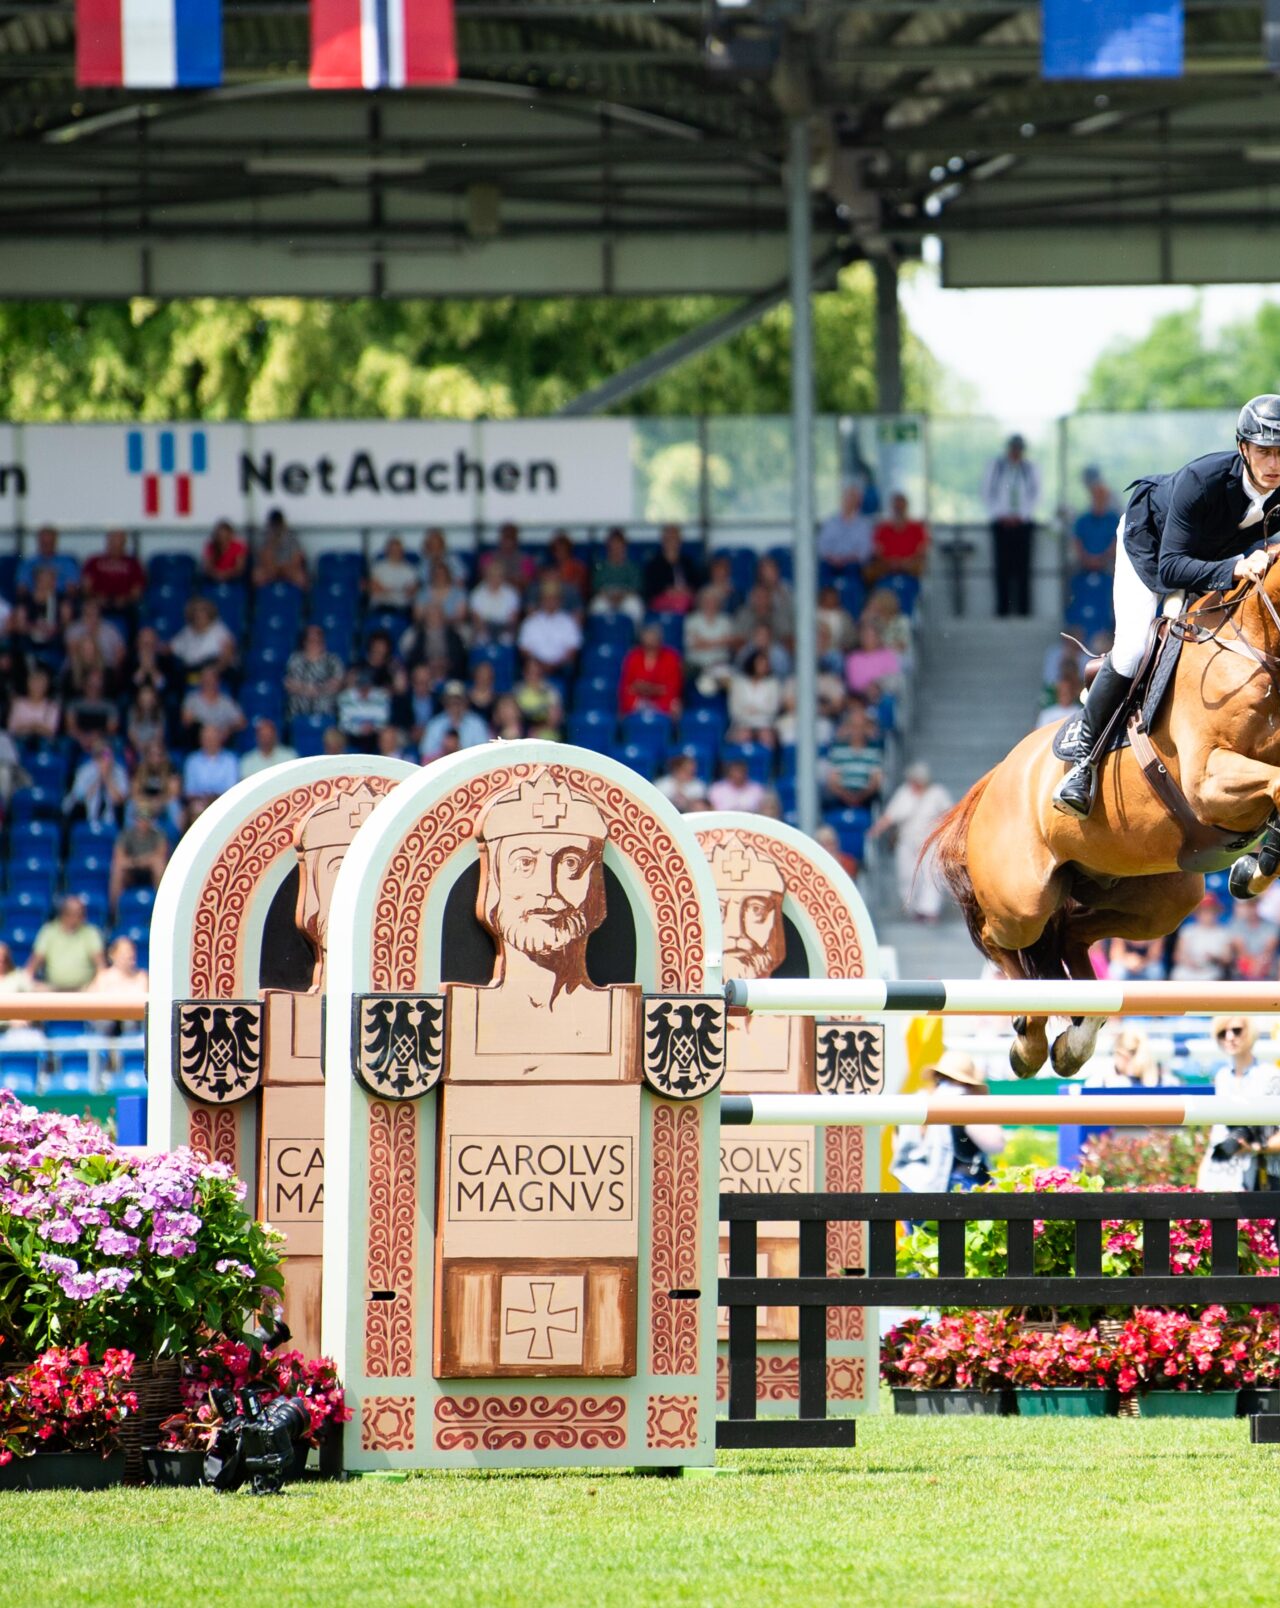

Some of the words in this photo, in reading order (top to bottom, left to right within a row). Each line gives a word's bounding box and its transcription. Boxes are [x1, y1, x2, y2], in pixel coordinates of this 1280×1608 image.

[239, 451, 558, 496] NetAachen
[458, 1144, 625, 1176] CAROLVS
[457, 1181, 624, 1212] MAGNVS
